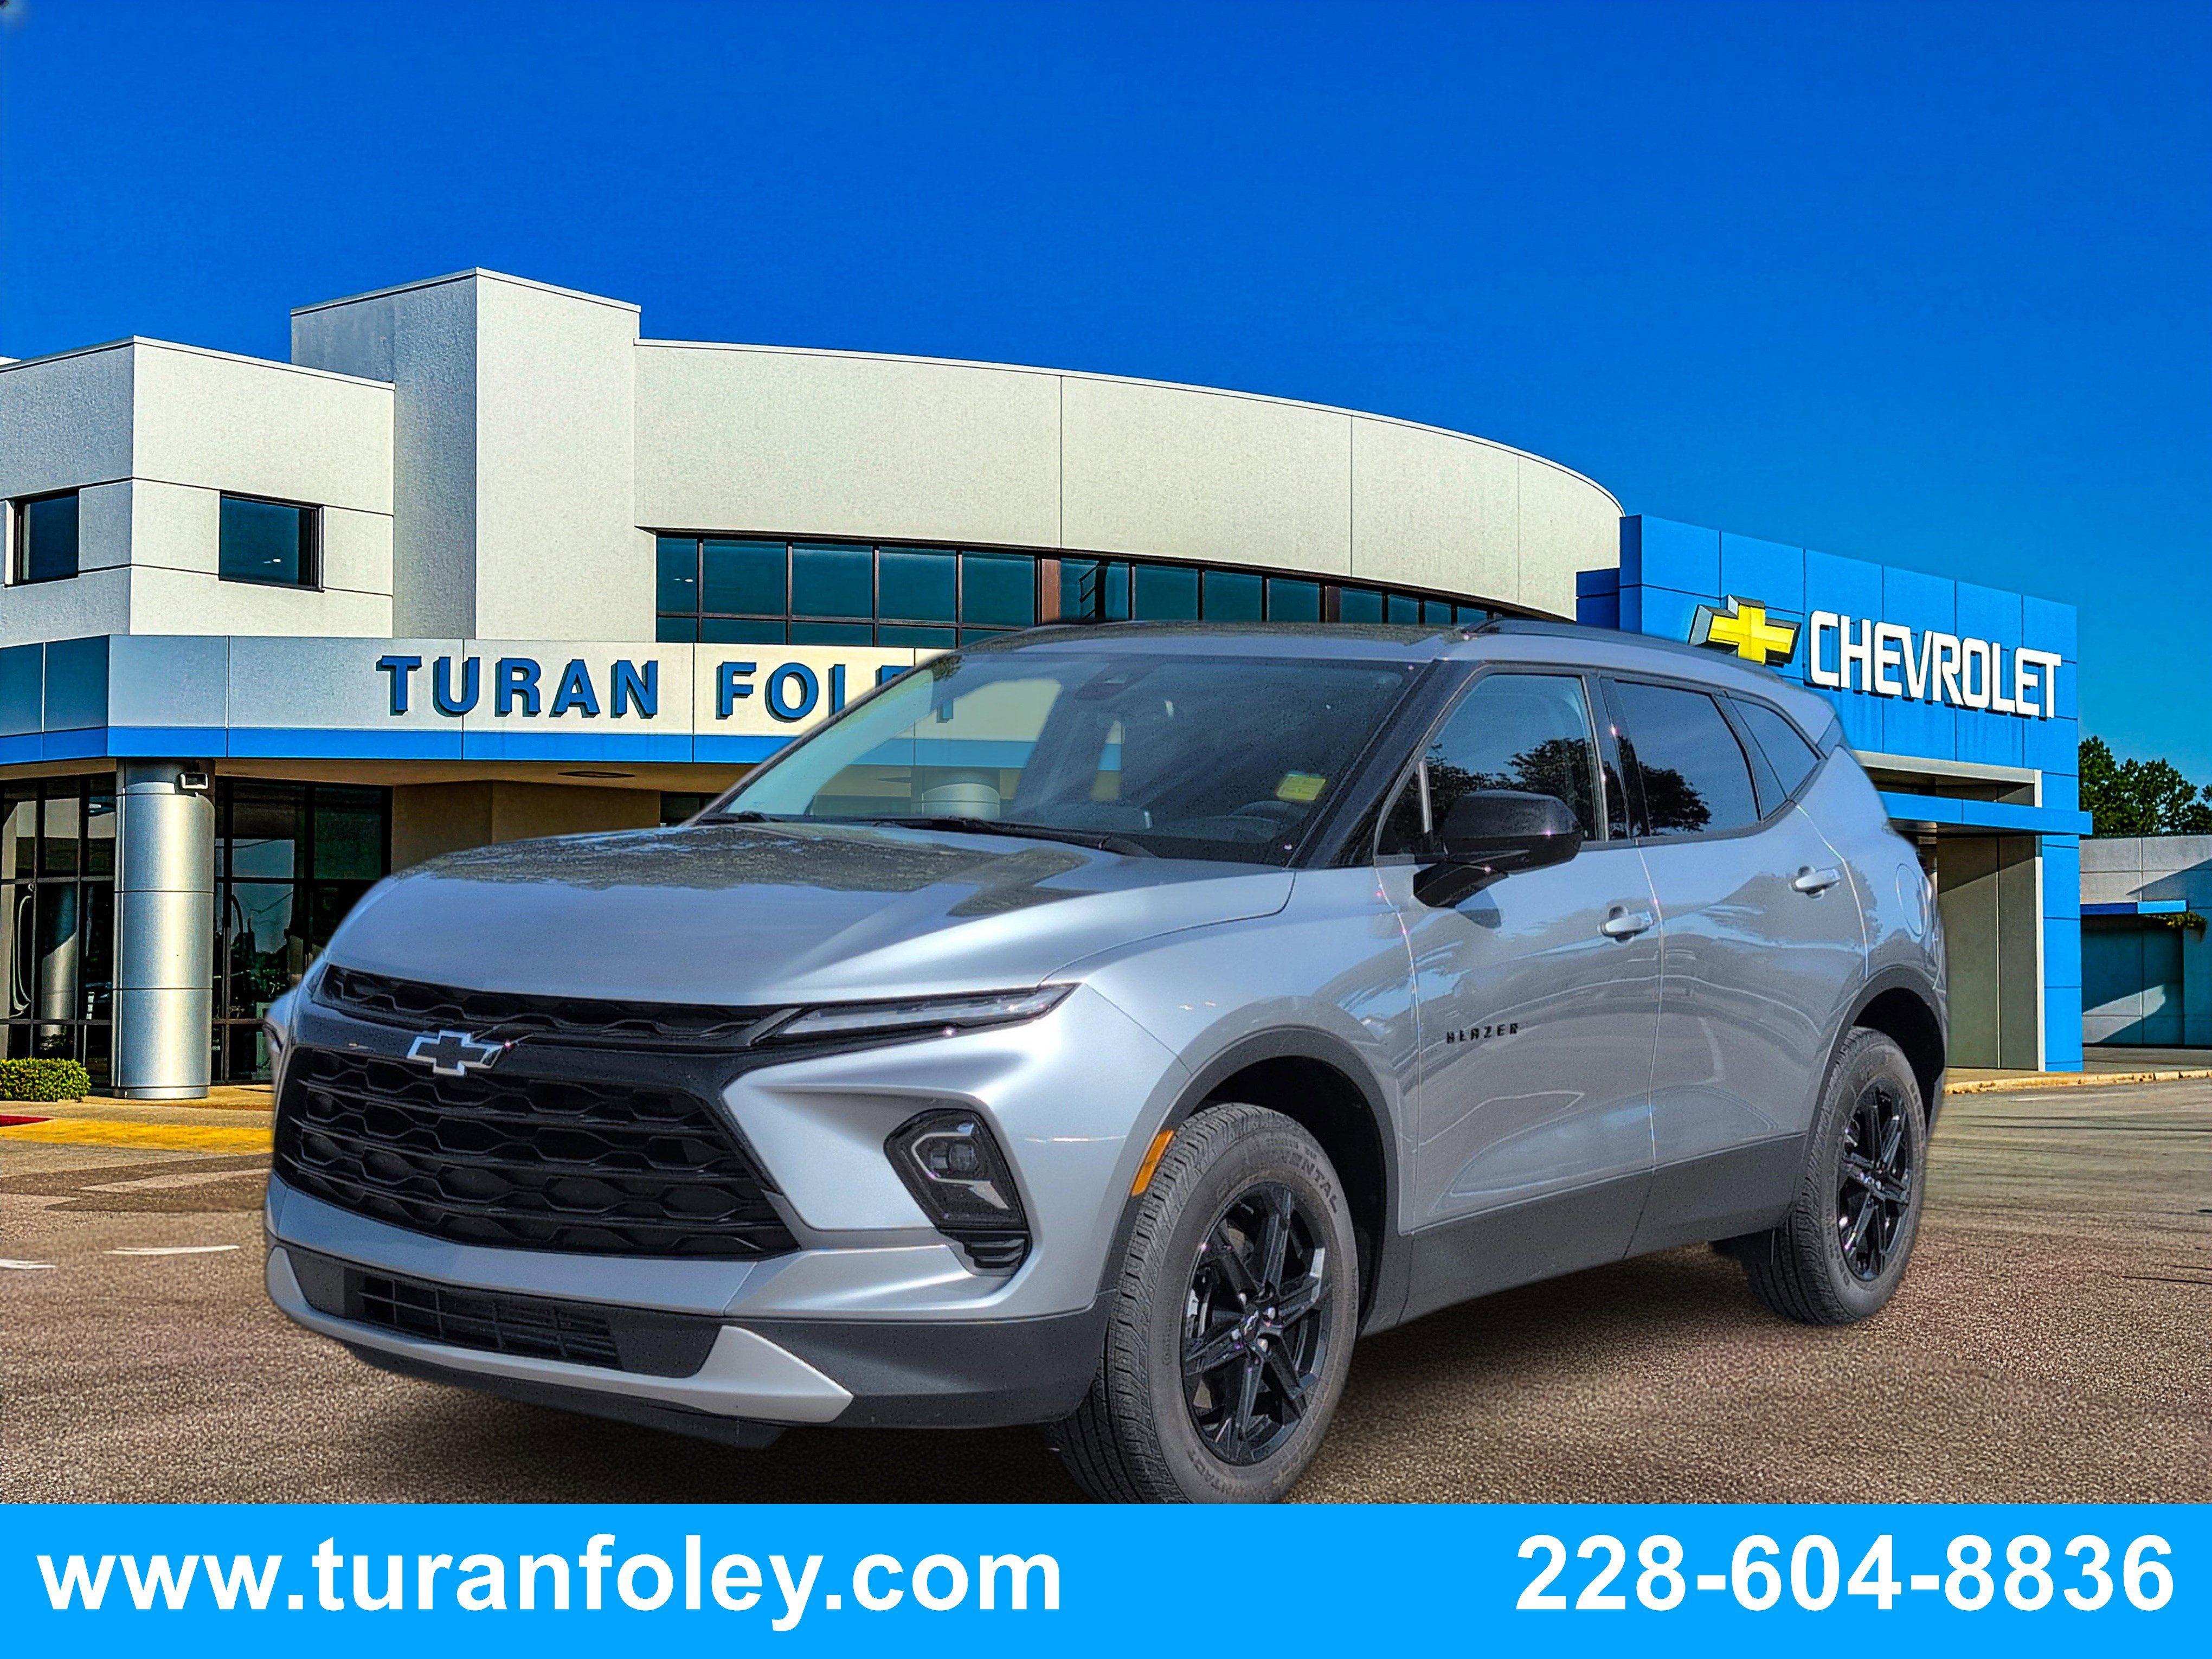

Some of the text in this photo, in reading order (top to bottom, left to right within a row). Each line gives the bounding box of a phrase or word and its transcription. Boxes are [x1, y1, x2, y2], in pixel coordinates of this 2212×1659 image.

[376, 654, 954, 723] TURAN FOL
[1810, 610, 2061, 718] CHEVROLET
